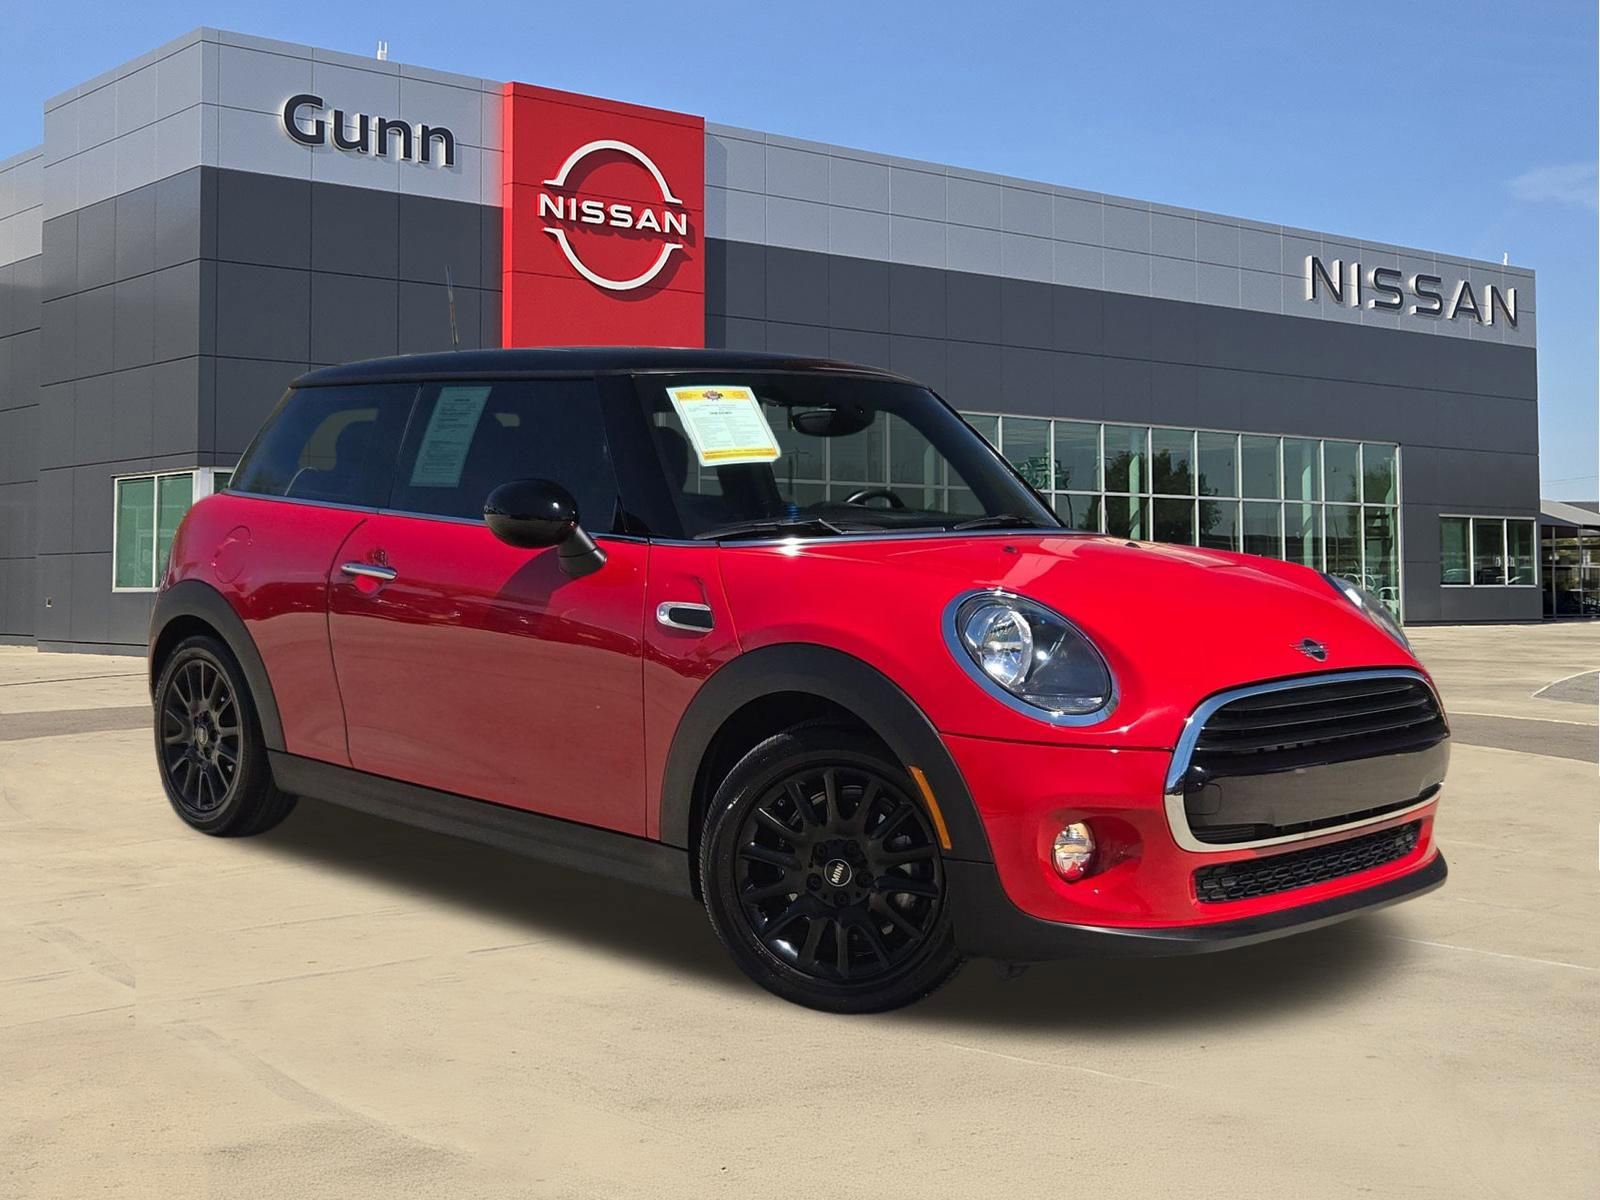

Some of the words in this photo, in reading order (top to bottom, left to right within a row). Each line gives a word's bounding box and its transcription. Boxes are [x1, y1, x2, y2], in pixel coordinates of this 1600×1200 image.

[282, 93, 455, 166] Gunn
[538, 193, 687, 236] NISSAN
[1305, 255, 1518, 328] NISSAN
[831, 863, 844, 883] MINI
